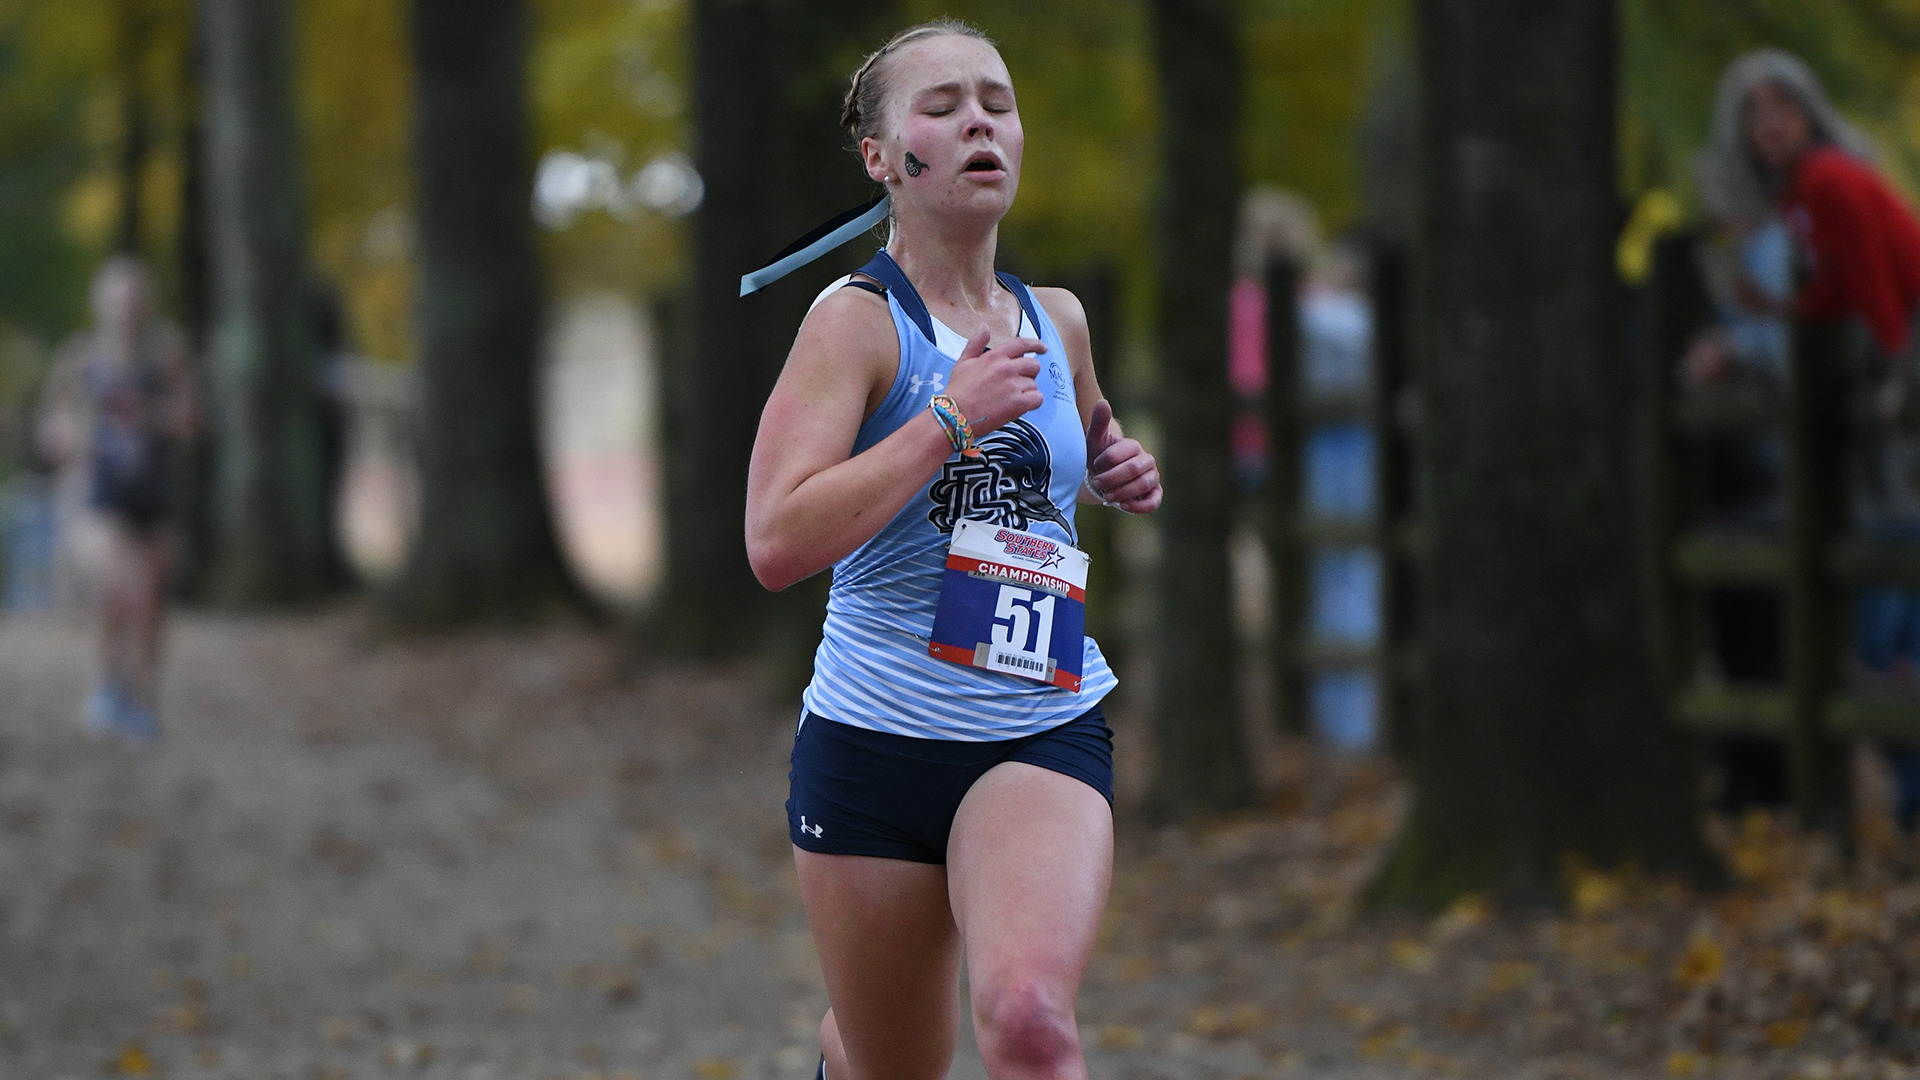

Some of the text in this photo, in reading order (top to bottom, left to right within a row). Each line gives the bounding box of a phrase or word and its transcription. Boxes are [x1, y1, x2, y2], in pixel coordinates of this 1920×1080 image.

[994, 529, 1056, 551] SOUTHERN
[1004, 542, 1048, 561] STATES
[978, 562, 1070, 593] CHAMPIONSHIP
[991, 584, 1056, 655] 51
